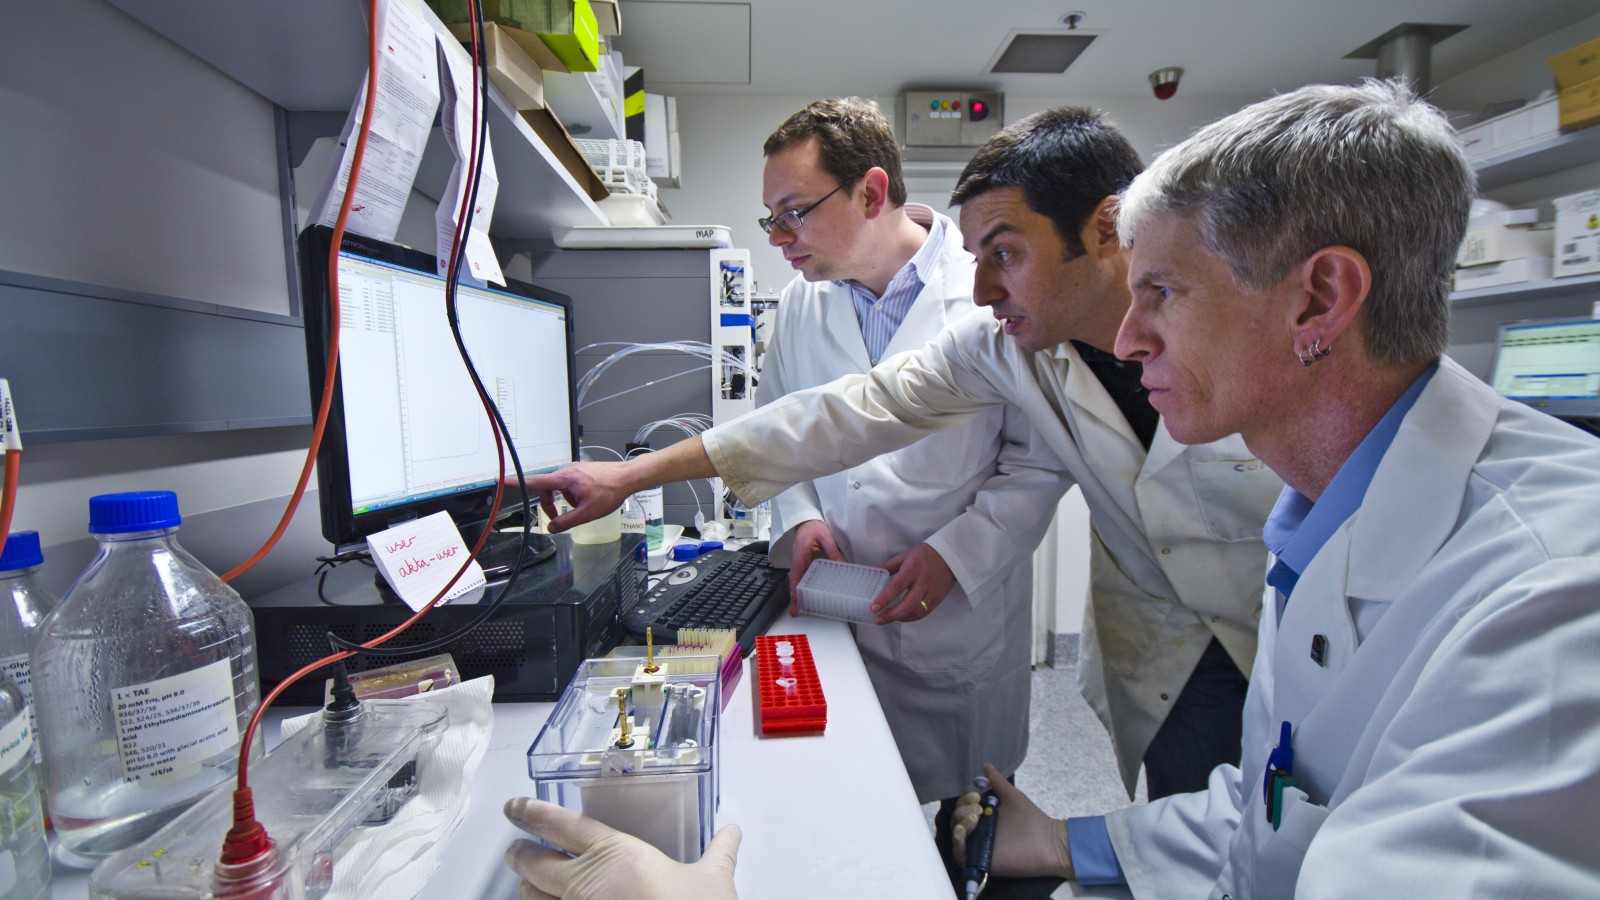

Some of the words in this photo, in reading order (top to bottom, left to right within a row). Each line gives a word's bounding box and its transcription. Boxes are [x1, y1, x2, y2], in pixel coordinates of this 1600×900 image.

[695, 230, 714, 239] MAP
[386, 536, 417, 554] user
[132, 688, 150, 698] TAE
